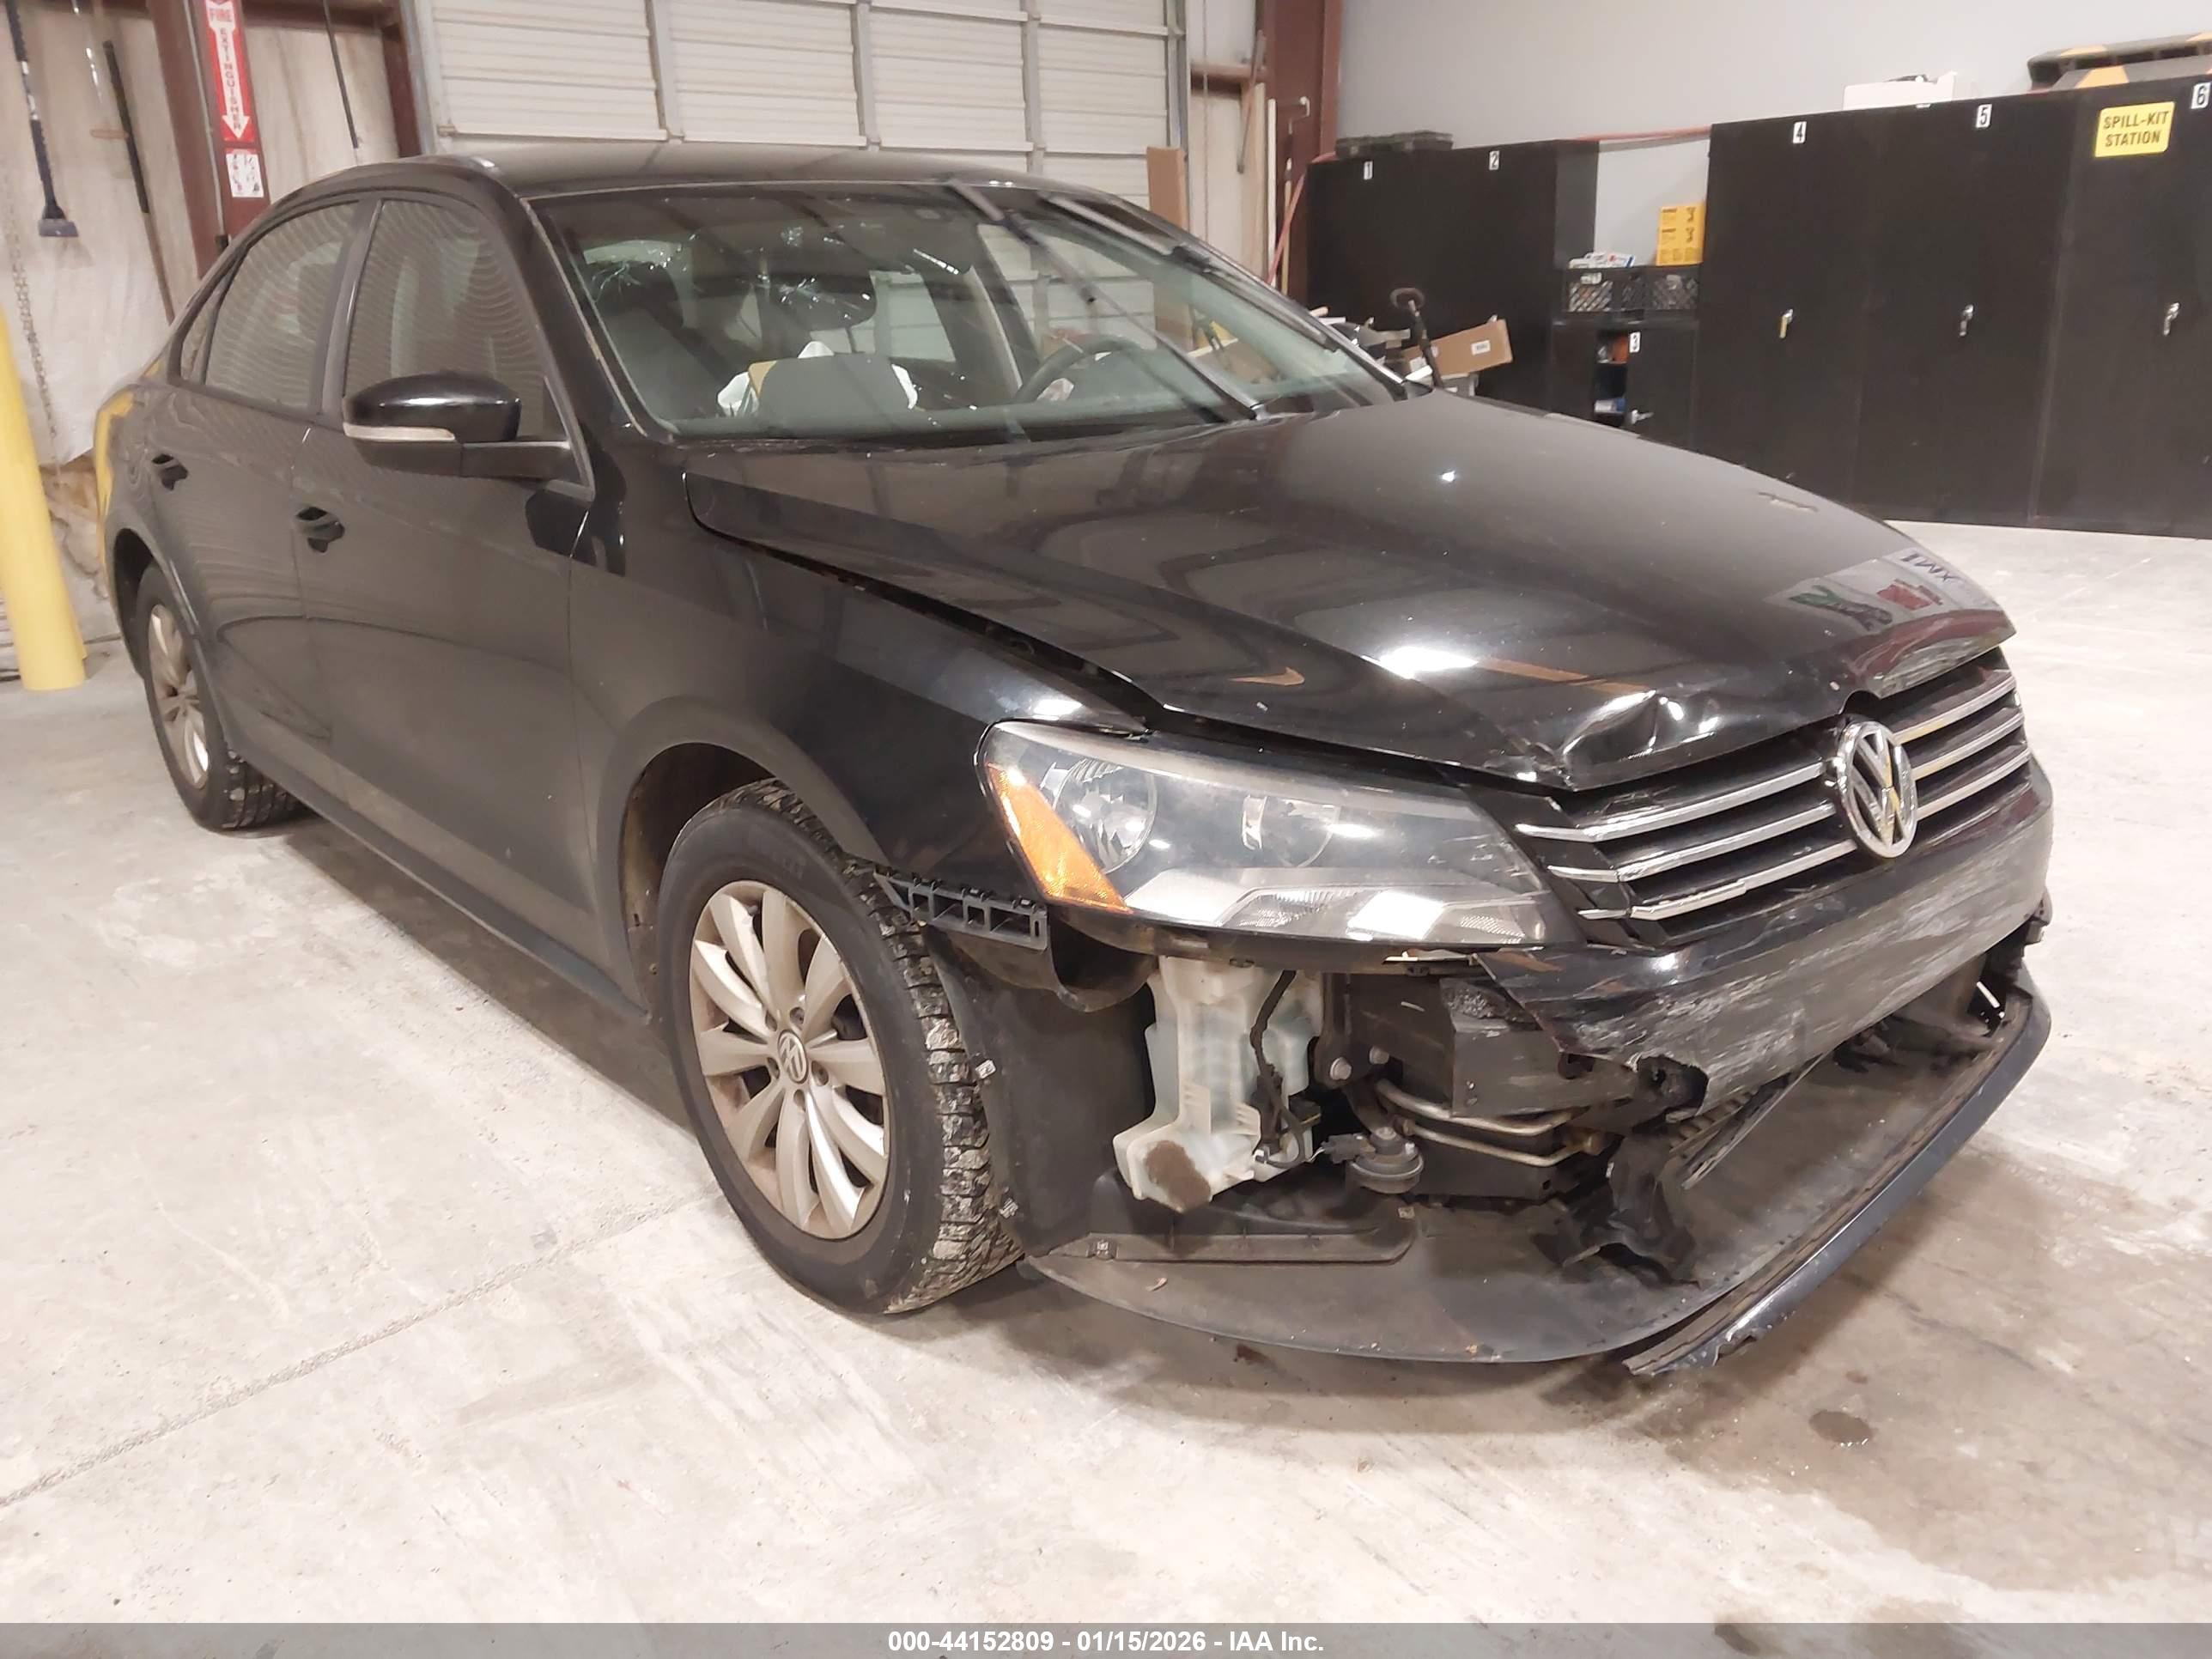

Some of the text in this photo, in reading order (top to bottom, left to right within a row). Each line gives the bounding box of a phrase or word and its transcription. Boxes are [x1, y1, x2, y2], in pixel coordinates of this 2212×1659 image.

[219, 27, 241, 130] EXTINGUISHER
[2196, 85, 2207, 106] 6
[1979, 106, 1989, 126] 5
[2103, 110, 2170, 130] SPILL-KIT
[2105, 131, 2162, 148] STATION
[1491, 151, 1499, 169] 2
